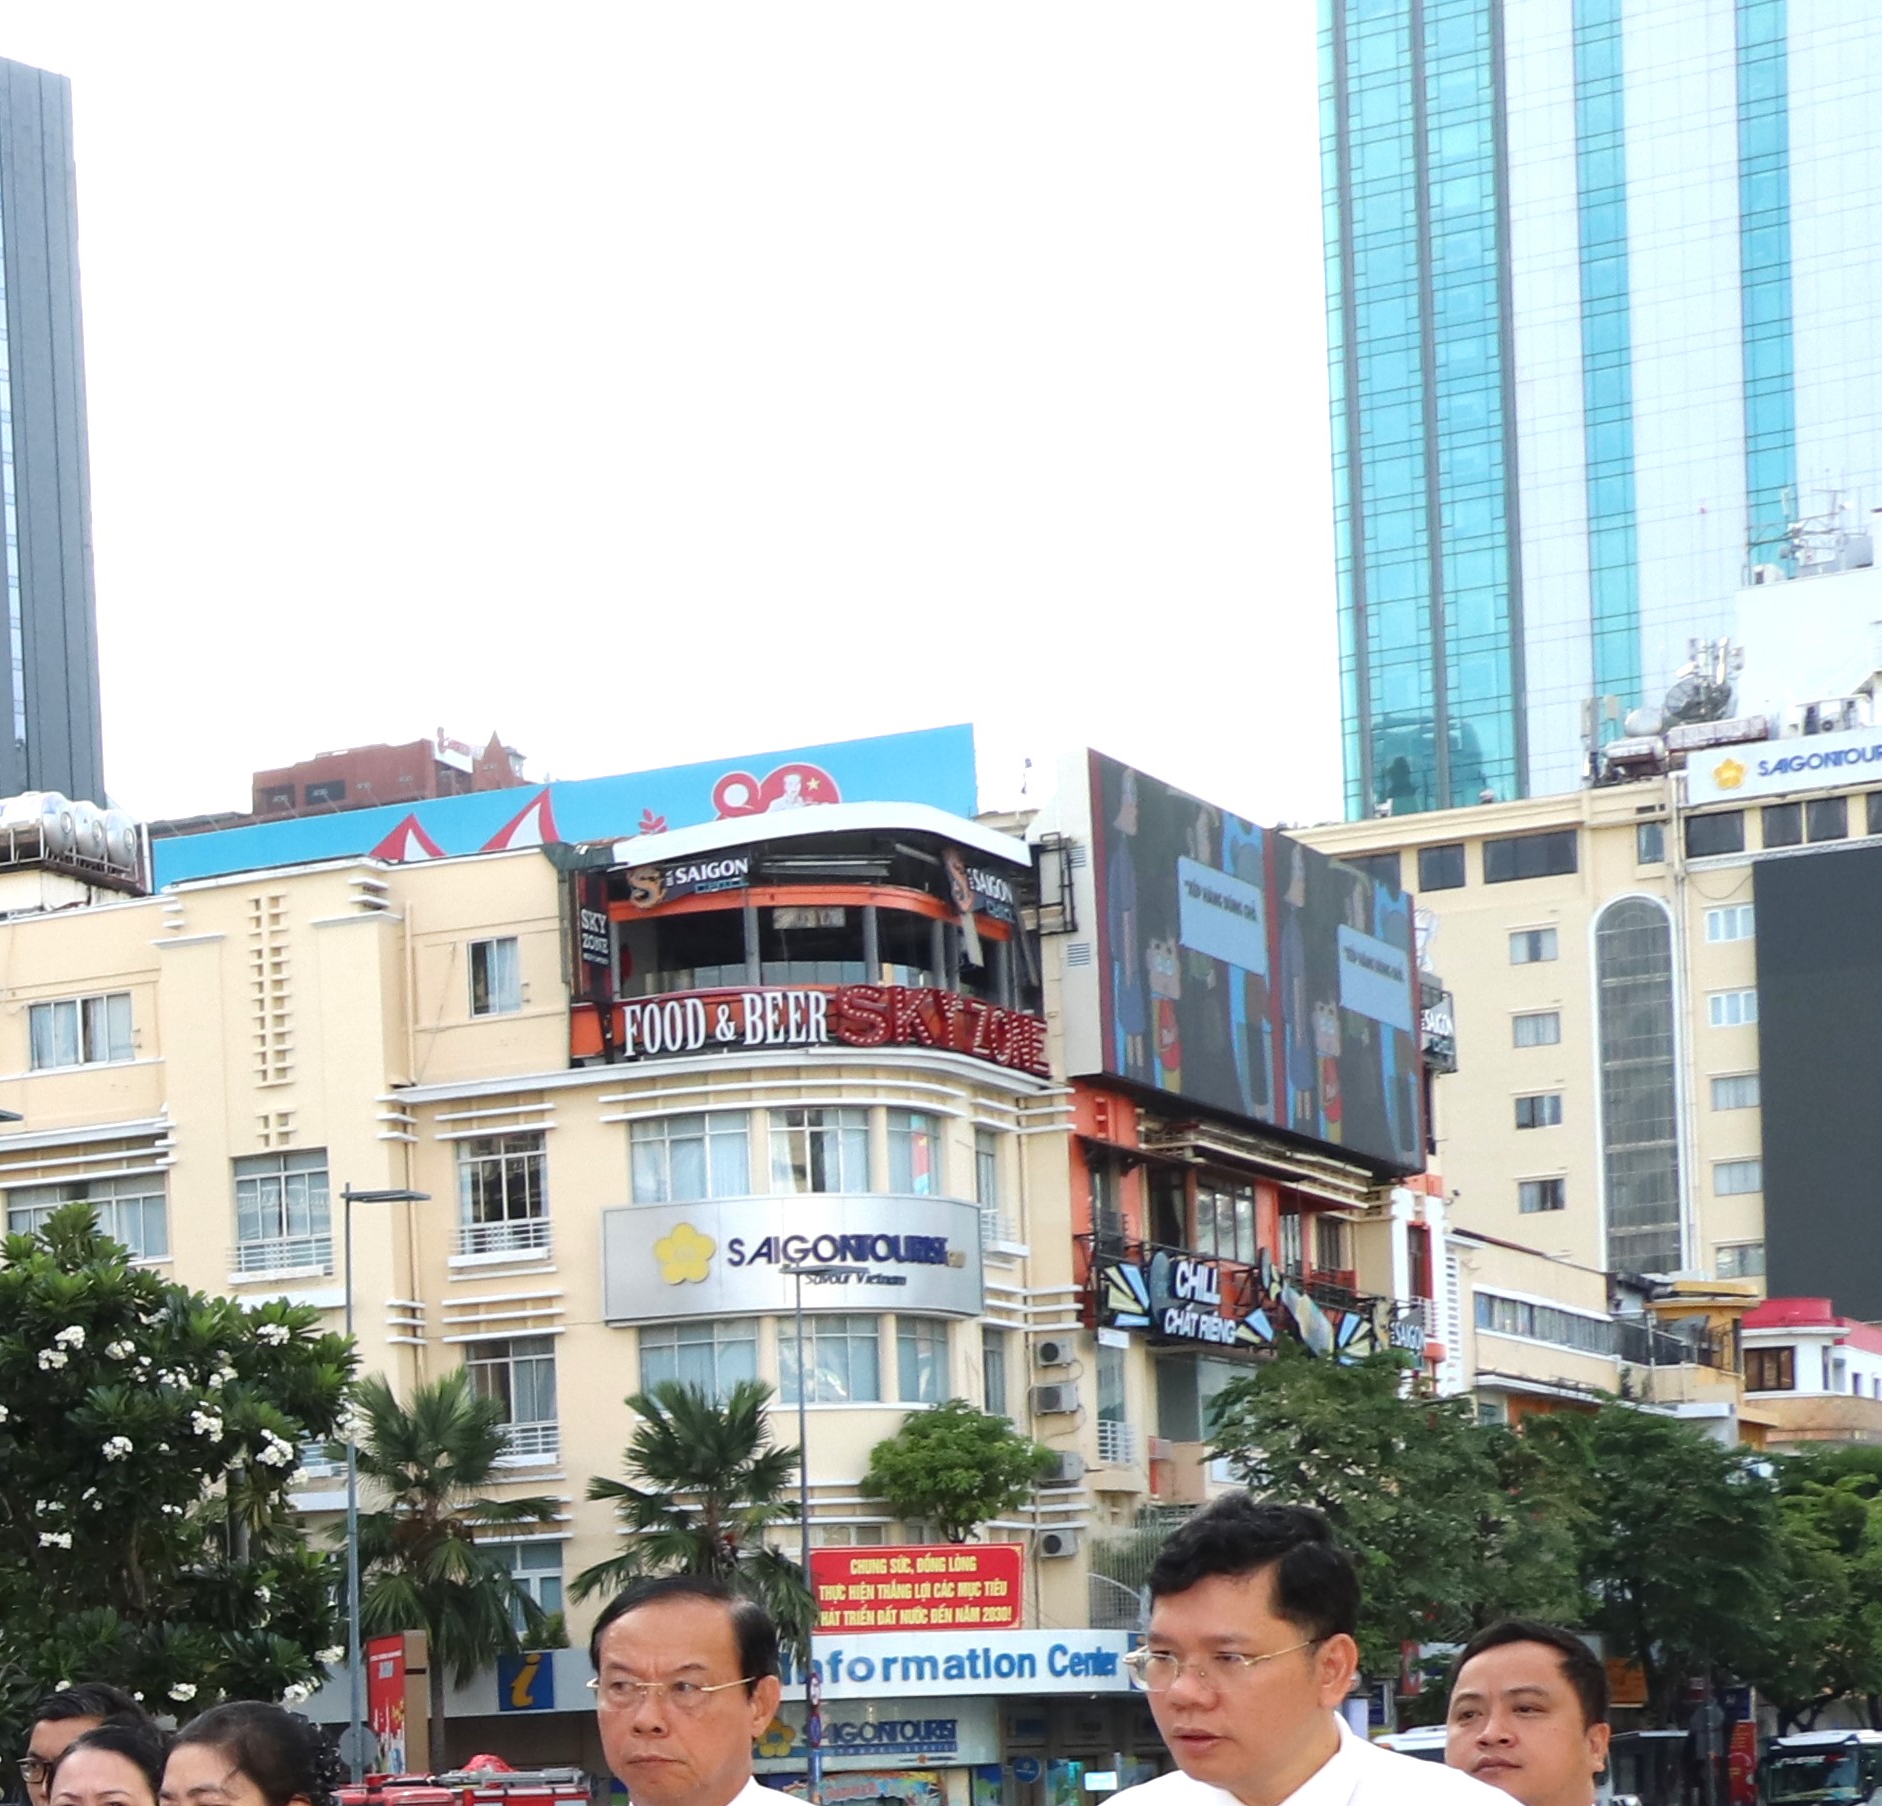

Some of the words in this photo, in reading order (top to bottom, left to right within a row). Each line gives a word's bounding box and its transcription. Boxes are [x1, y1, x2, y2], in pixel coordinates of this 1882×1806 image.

[676, 858, 749, 885] SAIGON
[970, 867, 1013, 903] SAIGON
[581, 909, 607, 933] SKY
[582, 933, 609, 954] ZONE
[623, 998, 706, 1057] FOOD
[715, 1003, 735, 1041] &
[742, 990, 829, 1046] BEER
[837, 984, 965, 1049] SKY
[970, 999, 1051, 1076] ZONE
[1175, 1261, 1221, 1304] CHILL
[1164, 1304, 1198, 1338] CHẤT
[850, 1558, 887, 1574] CHUNG
[818, 1584, 846, 1604] THỰC
[848, 1580, 875, 1603] HIỆN
[877, 1579, 912, 1599] THẮNG
[933, 1580, 956, 1598] CÁC
[957, 1581, 982, 1601] MỤC
[815, 1607, 841, 1627] HÁT
[843, 1603, 875, 1627] TRIỂN
[877, 1604, 897, 1625] ĐẤT
[899, 1606, 928, 1625] NƯỚC
[930, 1605, 952, 1624] ĐẾN
[955, 1605, 980, 1623] NĂM
[1048, 1643, 1118, 1678] Center
